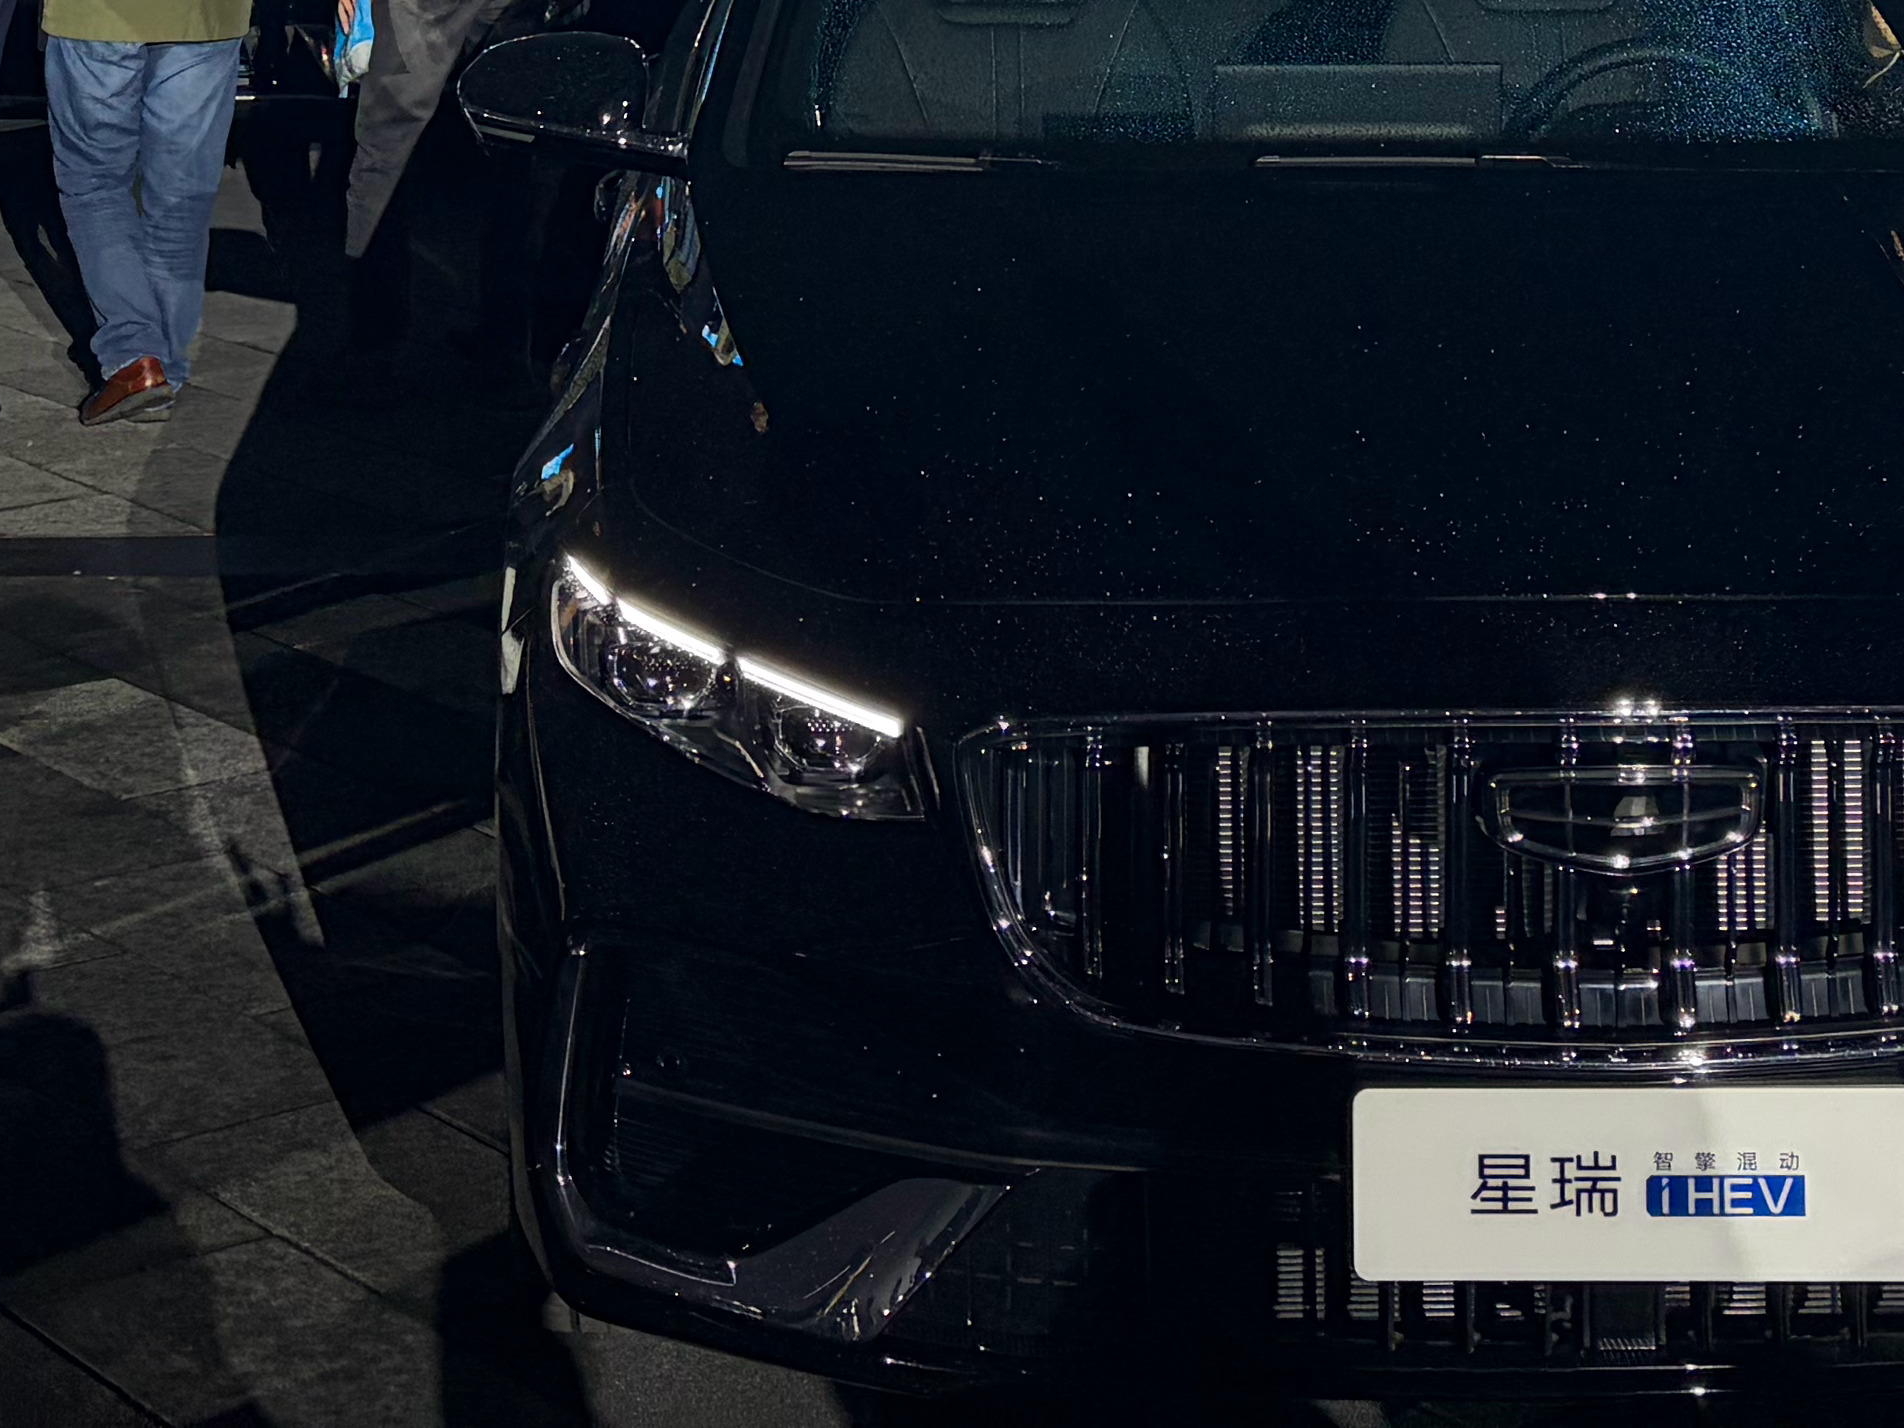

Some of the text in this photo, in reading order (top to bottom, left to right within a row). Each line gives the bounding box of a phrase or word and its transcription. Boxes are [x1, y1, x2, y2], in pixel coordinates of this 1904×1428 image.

[1653, 1151, 1799, 1172] 智擎混动
[1470, 1150, 1622, 1218] 星瑞
